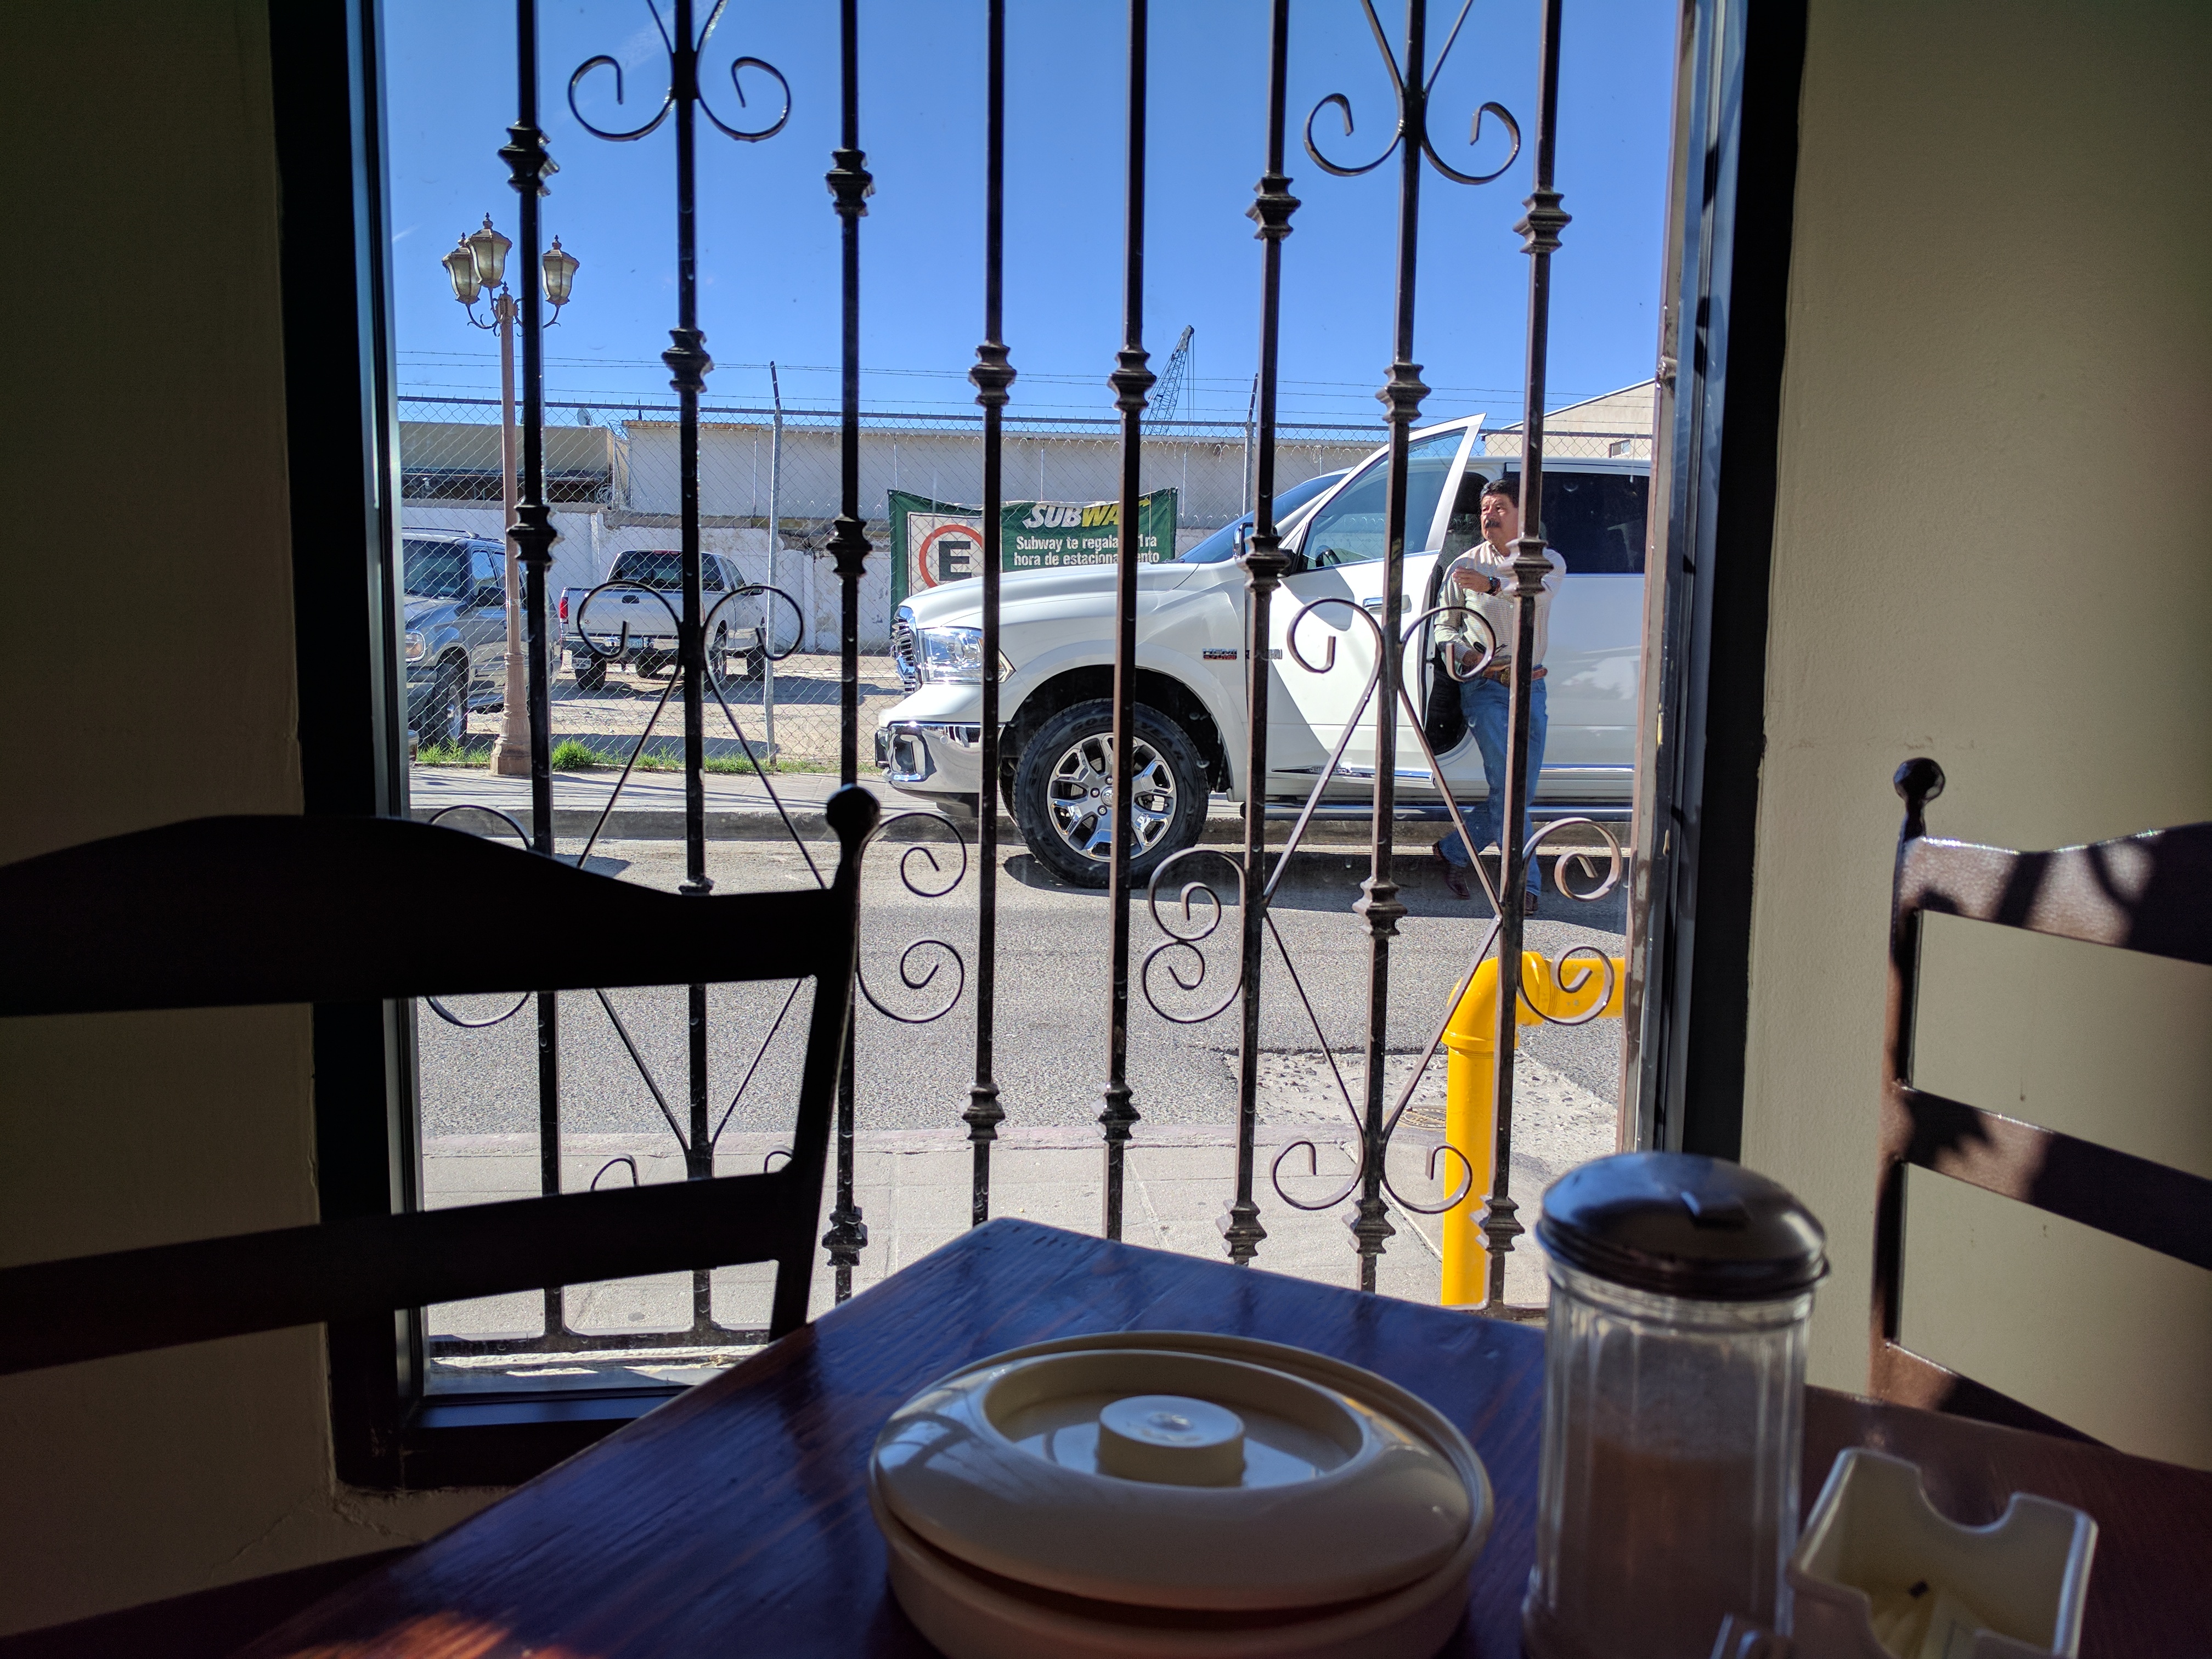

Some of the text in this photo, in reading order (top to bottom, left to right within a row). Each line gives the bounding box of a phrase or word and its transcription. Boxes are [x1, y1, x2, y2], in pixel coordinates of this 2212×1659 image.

[1022, 498, 1151, 529] SUBWA
[1014, 551, 1159, 566] hora de estacionaento
[1016, 534, 1157, 552] Subway te regala 1ra
[939, 541, 972, 581] E
[1070, 715, 1185, 761] GOOYEAR
